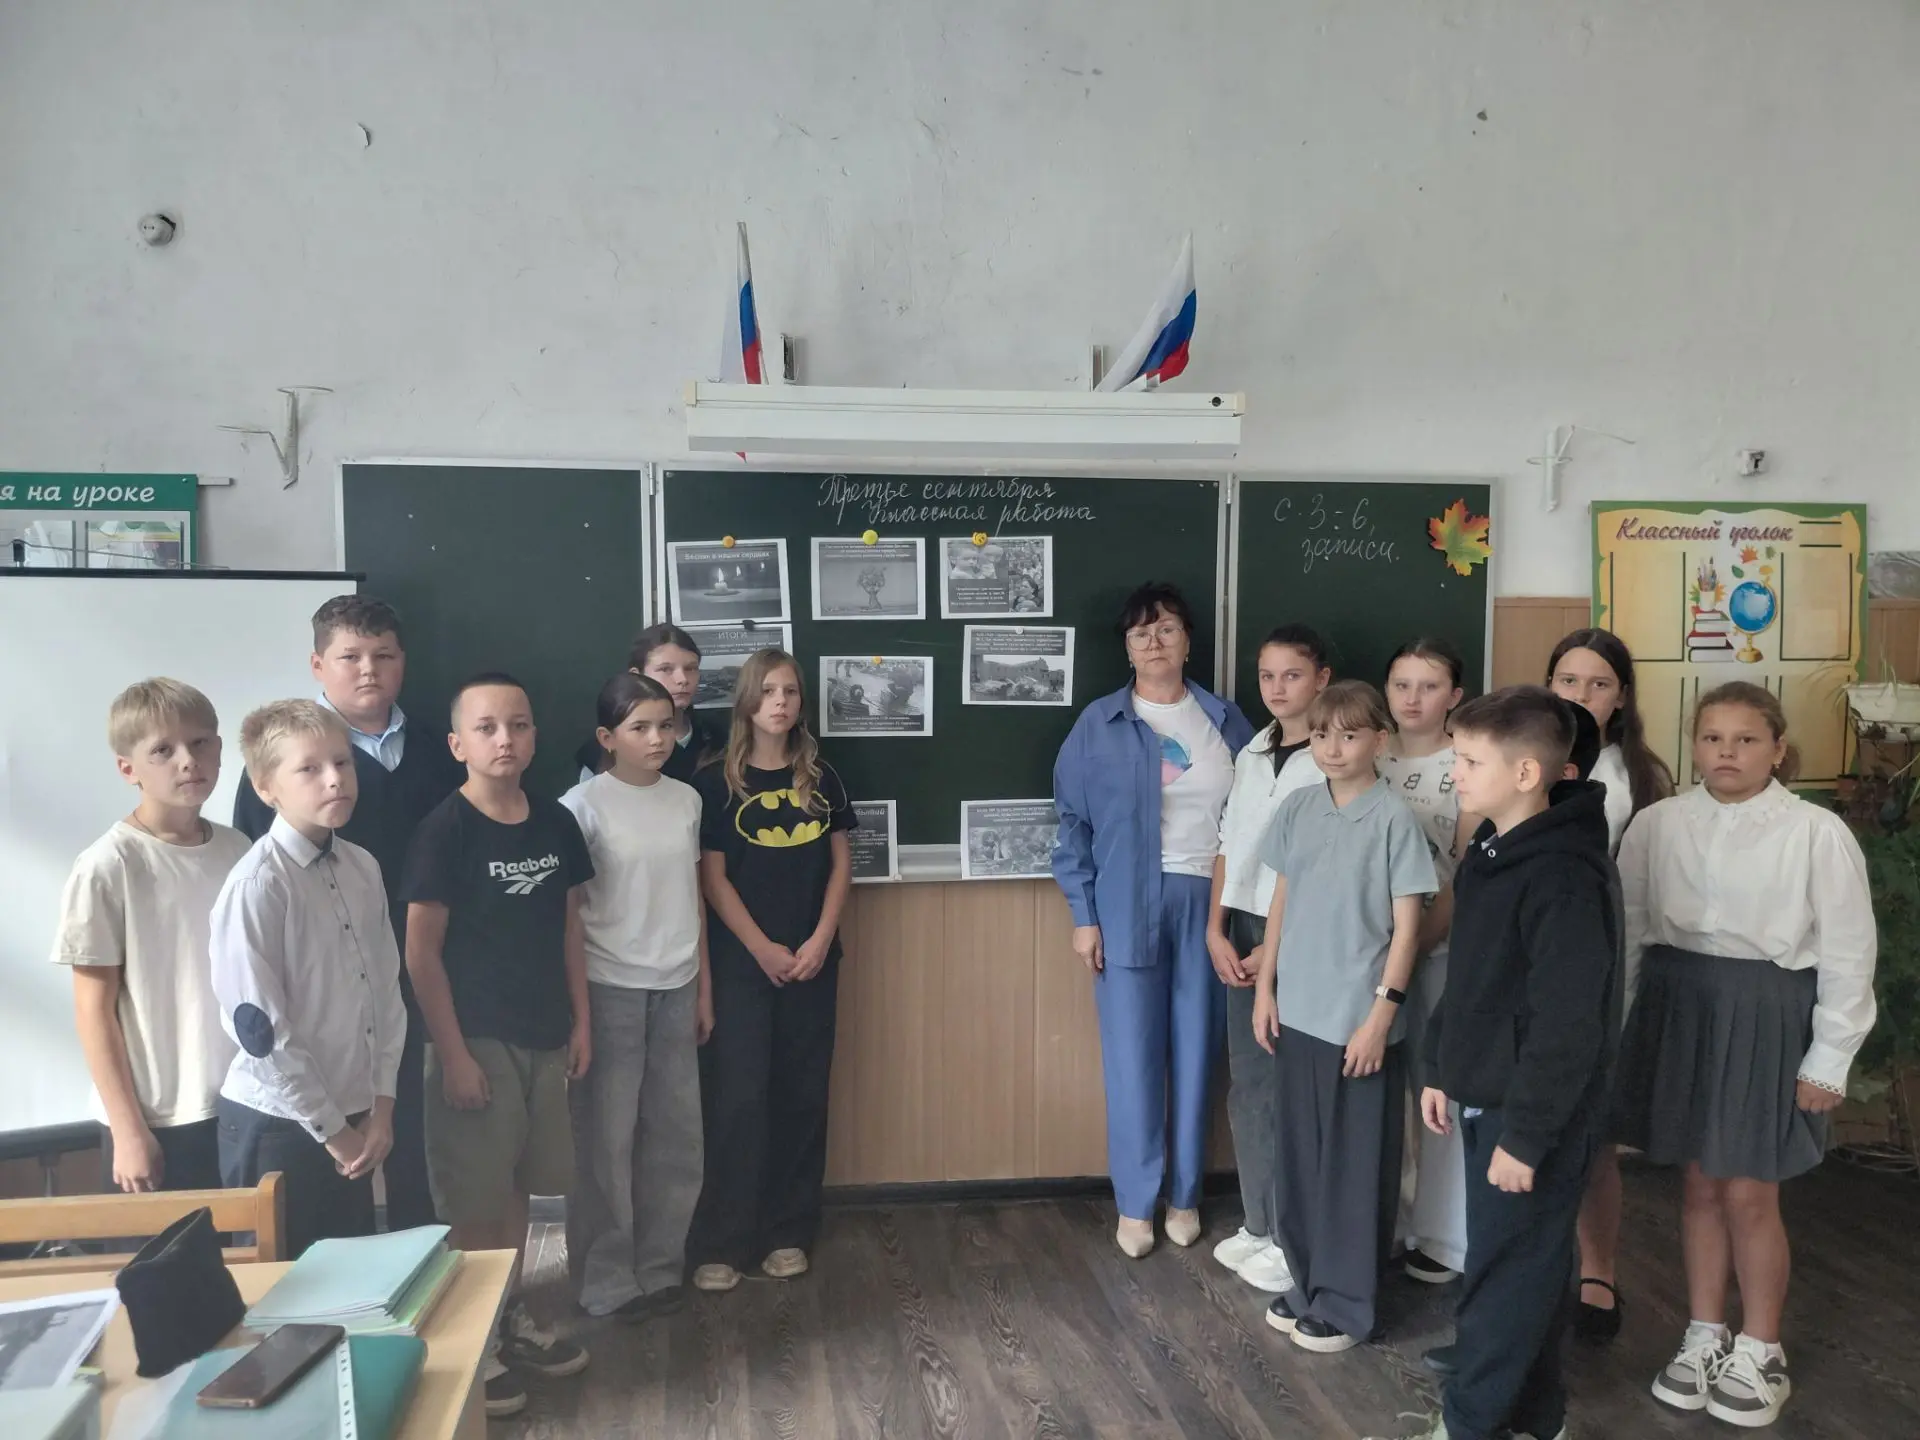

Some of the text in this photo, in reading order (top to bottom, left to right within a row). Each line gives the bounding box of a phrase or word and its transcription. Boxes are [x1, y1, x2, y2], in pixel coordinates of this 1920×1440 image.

[0, 485, 156, 508] я на уроке
[818, 474, 1056, 526] Третье сентября
[861, 499, 1097, 537] Классная работа
[1615, 516, 1794, 548] Классный уголок
[488, 853, 560, 878] Reebok
